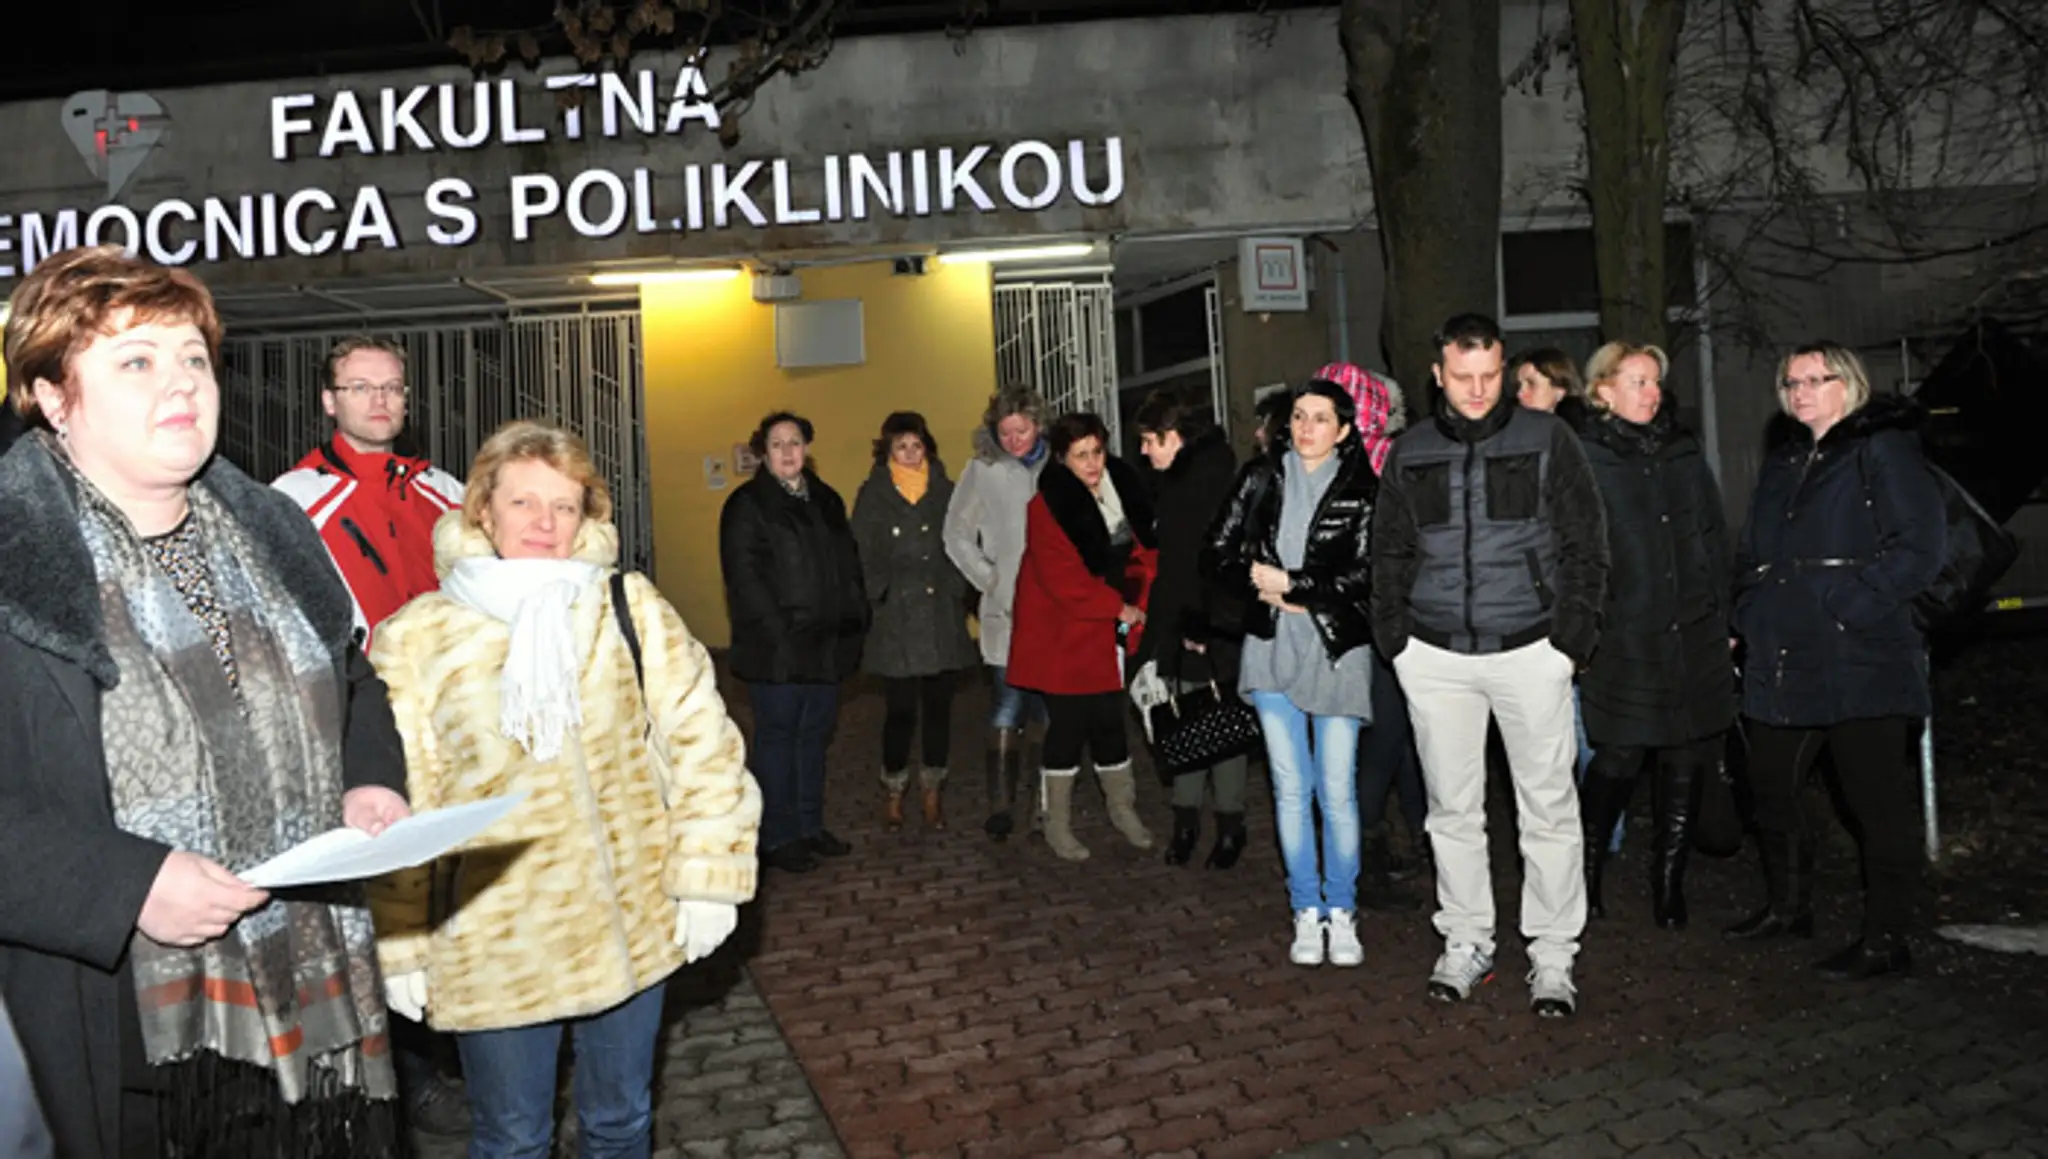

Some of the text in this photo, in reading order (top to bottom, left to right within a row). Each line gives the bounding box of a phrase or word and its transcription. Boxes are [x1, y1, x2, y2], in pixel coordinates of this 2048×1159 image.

[270, 51, 722, 160] FAKULTNÁ
[424, 178, 478, 245] S
[510, 137, 1125, 240] POLIKLINIKOU
